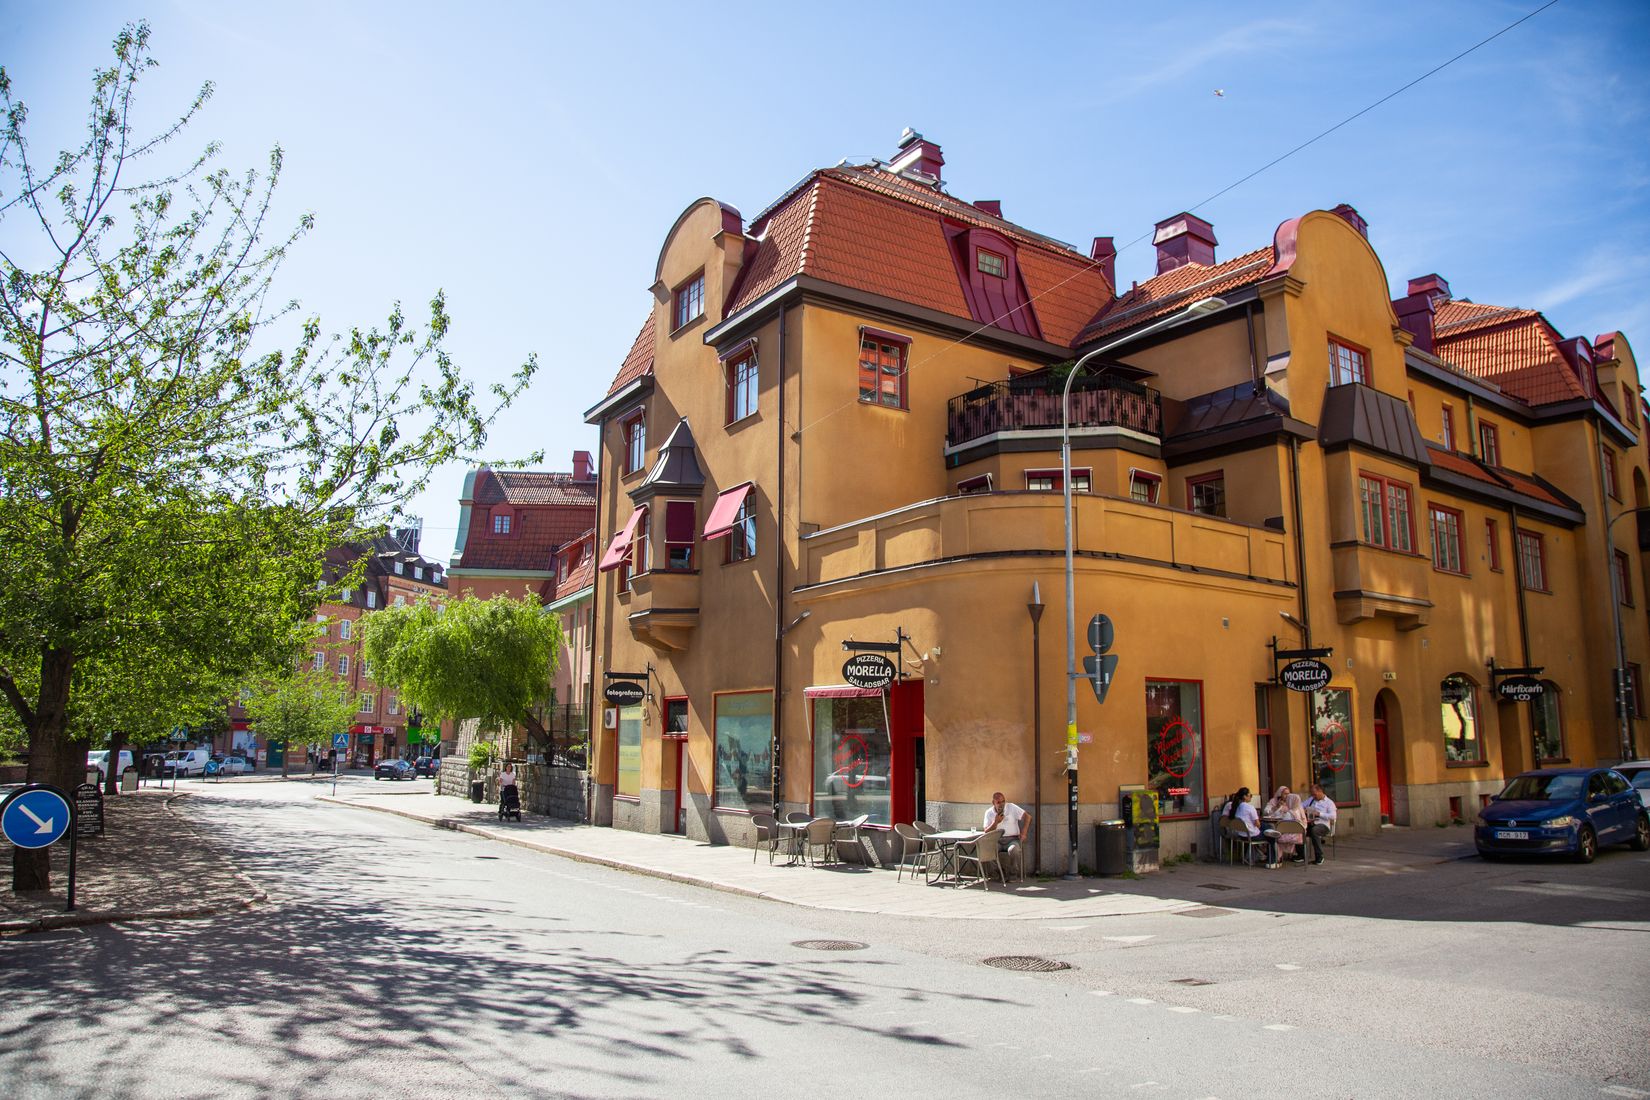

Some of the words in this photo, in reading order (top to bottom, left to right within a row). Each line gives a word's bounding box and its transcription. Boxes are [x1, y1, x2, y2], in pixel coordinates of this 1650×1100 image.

[856, 655, 884, 665] PIZZERIA
[1291, 661, 1319, 670] PIZZERIA
[847, 665, 892, 677] MORELLA
[1284, 669, 1328, 681] MORELLA
[848, 676, 890, 689] SALLADSBAR
[606, 689, 643, 698] fotograferna
